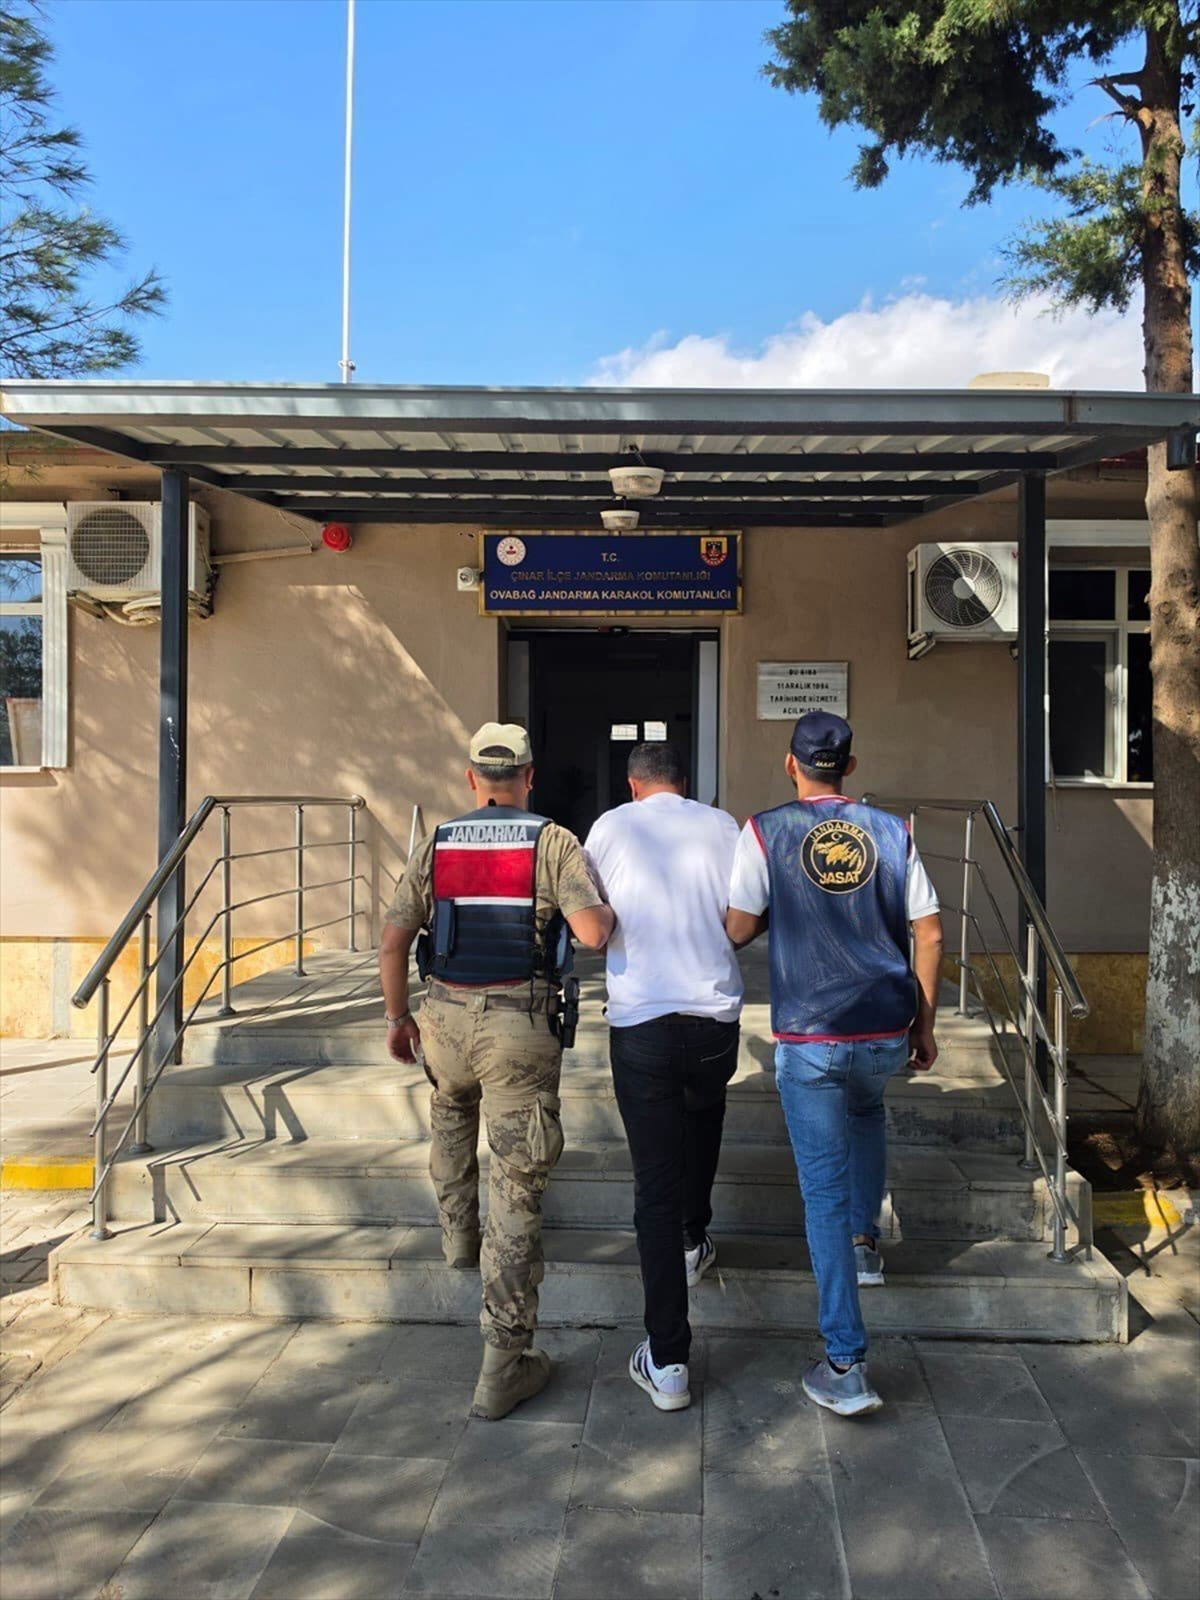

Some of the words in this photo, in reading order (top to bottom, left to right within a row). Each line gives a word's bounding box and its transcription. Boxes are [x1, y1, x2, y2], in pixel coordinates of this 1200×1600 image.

[601, 552, 620, 562] T.C.
[511, 571, 545, 583] ÇINAR
[547, 568, 571, 583] İLÇE
[574, 571, 634, 581] JANDARMA
[636, 569, 711, 581] KOMUTANLIĞI
[489, 589, 536, 600] OVABAĞ
[538, 590, 600, 600] JANDARMA
[601, 590, 655, 600] KARAKOL
[656, 589, 732, 600] KOMUTANLIĞI
[447, 826, 528, 842] JANDARMA
[809, 822, 866, 843] JANDARMA
[819, 871, 861, 885] JASAT
